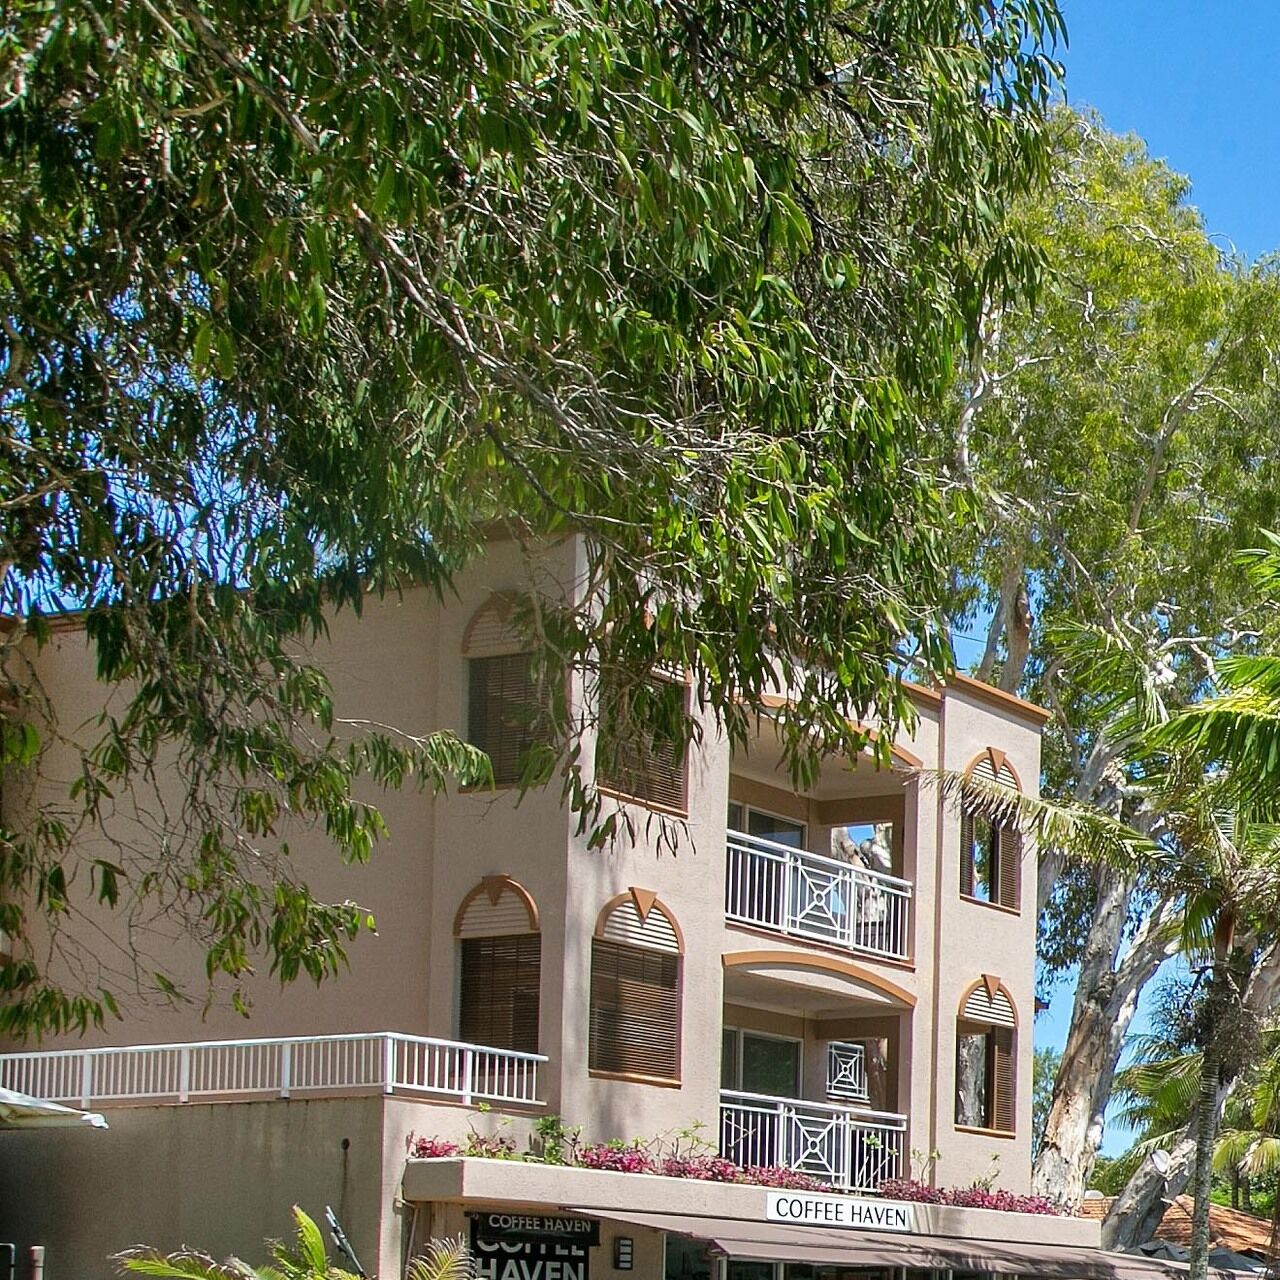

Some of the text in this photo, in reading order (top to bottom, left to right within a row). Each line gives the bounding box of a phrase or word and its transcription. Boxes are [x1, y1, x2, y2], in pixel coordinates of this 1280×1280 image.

[488, 1214, 592, 1232] COFFEE HAVEN
[776, 1198, 906, 1227] COFFEE HAVEN
